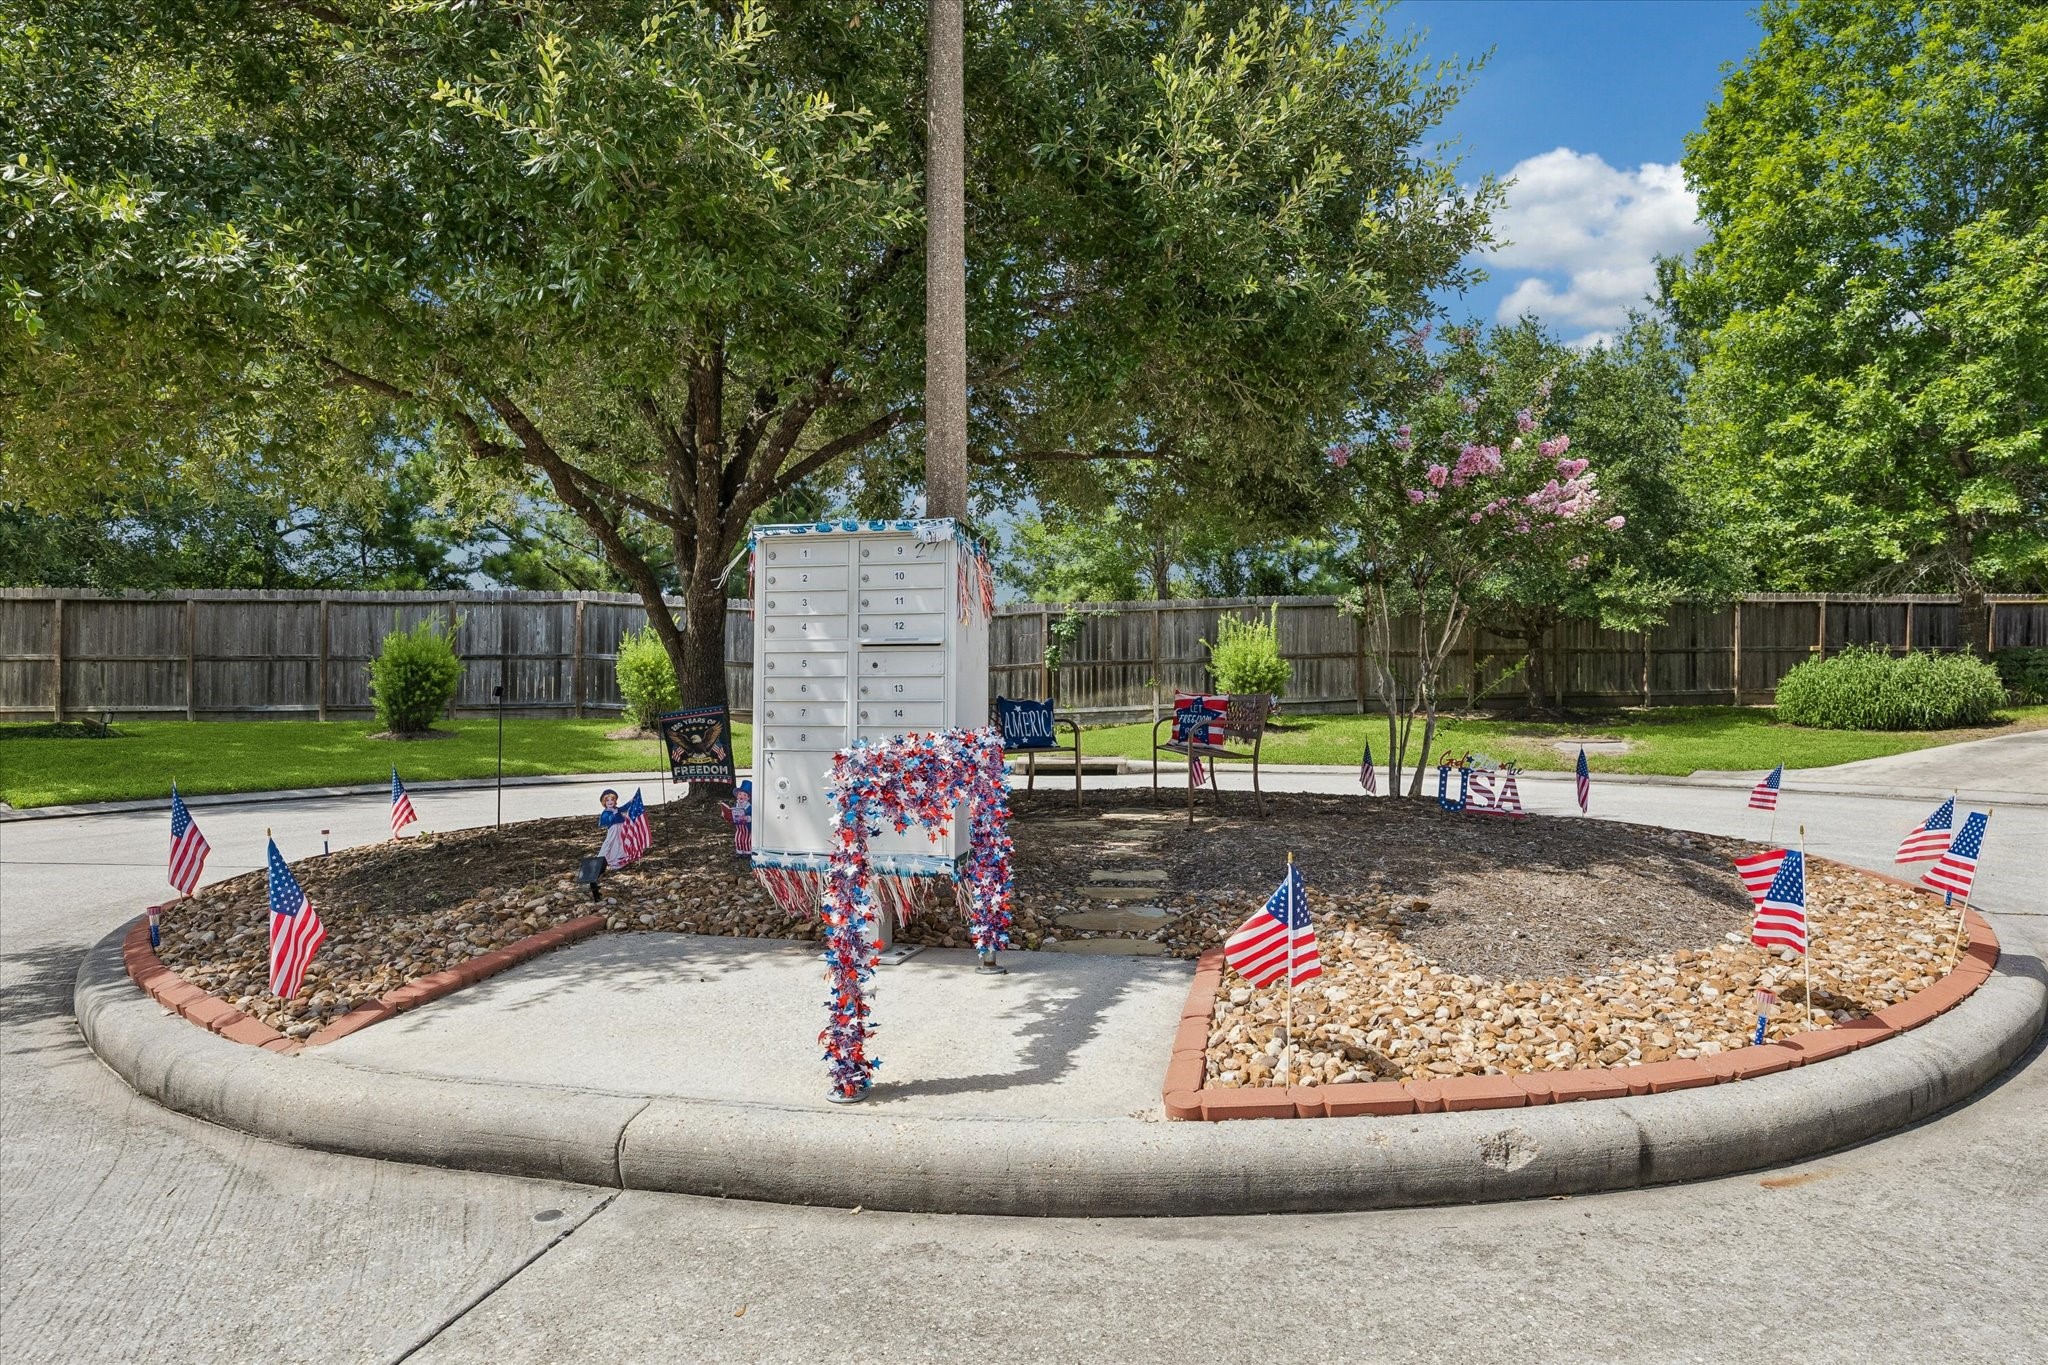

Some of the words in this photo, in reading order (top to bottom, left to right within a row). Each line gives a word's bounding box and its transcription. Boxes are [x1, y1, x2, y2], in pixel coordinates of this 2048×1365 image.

[802, 549, 808, 558] 1
[897, 546, 903, 555] 9
[802, 574, 808, 583] 2
[894, 571, 905, 581] 10
[802, 598, 808, 607] 3
[894, 596, 904, 605] 11
[801, 622, 808, 631] 4
[894, 621, 905, 630] 12
[801, 659, 808, 668] 5
[800, 684, 807, 693] 6
[894, 684, 904, 693] 13
[800, 708, 807, 717] 7
[1189, 704, 1203, 713] LET
[893, 709, 904, 718] 14
[683, 717, 706, 725] YEARS
[1179, 713, 1212, 724] FREEDOM
[1184, 727, 1203, 736] RG
[800, 733, 807, 742] 8
[1439, 749, 1470, 769] God
[1505, 759, 1525, 776] The
[674, 765, 728, 775] FREEDOM
[1437, 765, 1523, 814] USA
[797, 795, 808, 804] 1P
